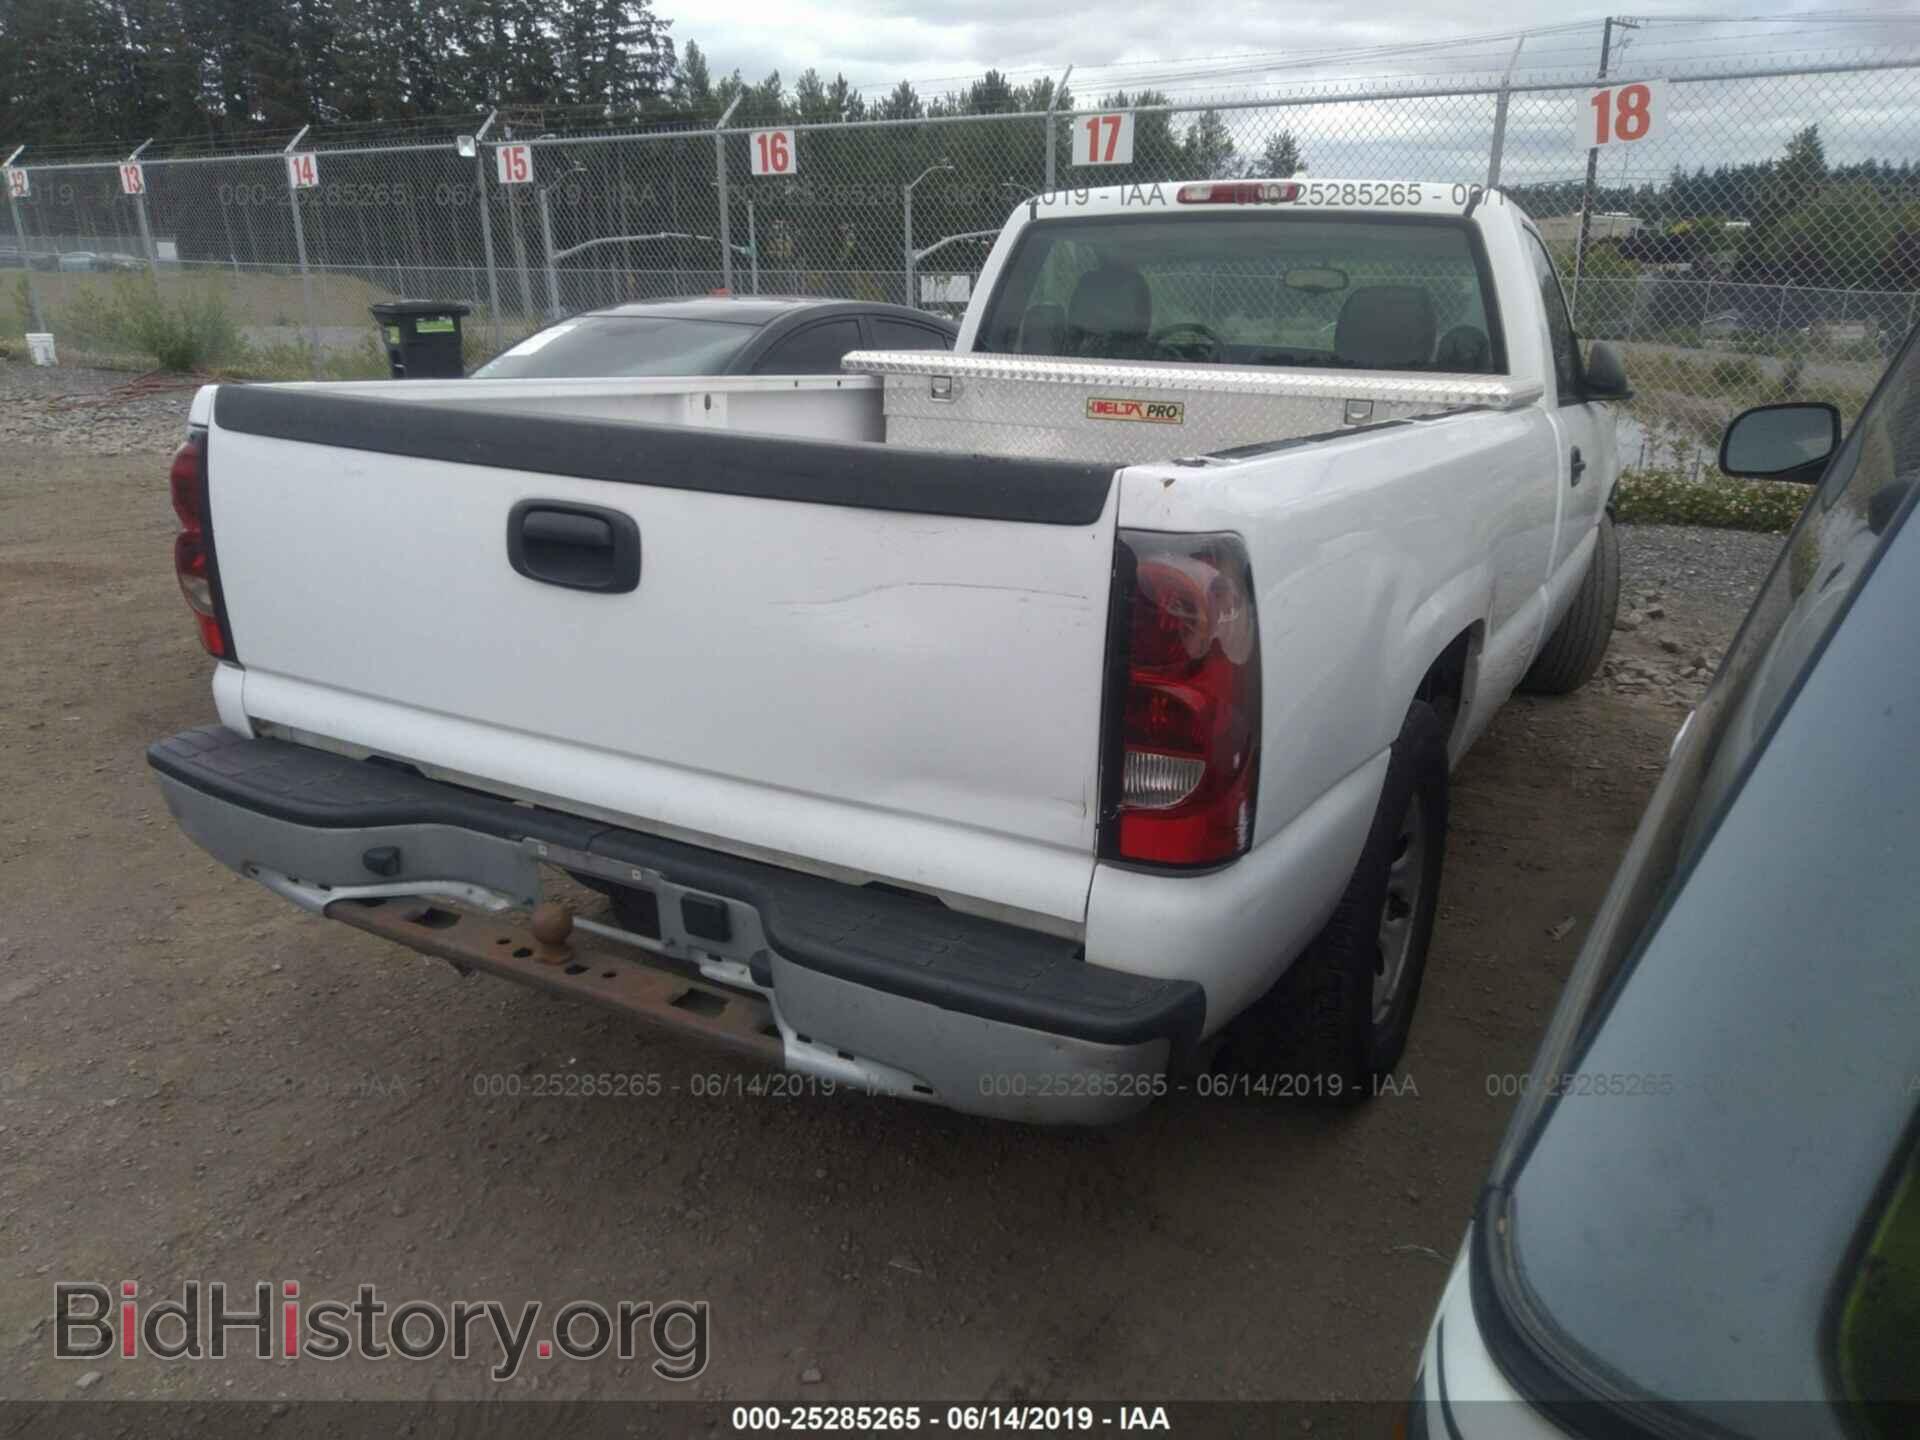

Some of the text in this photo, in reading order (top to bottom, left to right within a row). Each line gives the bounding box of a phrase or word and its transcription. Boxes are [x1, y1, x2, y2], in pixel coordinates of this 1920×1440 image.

[1591, 84, 1651, 145] 18
[757, 132, 789, 173] 16
[1086, 115, 1122, 163] 17
[124, 165, 142, 193] 13
[293, 155, 314, 186] 14
[502, 147, 528, 181] 15
[1146, 404, 1178, 418] PRO
